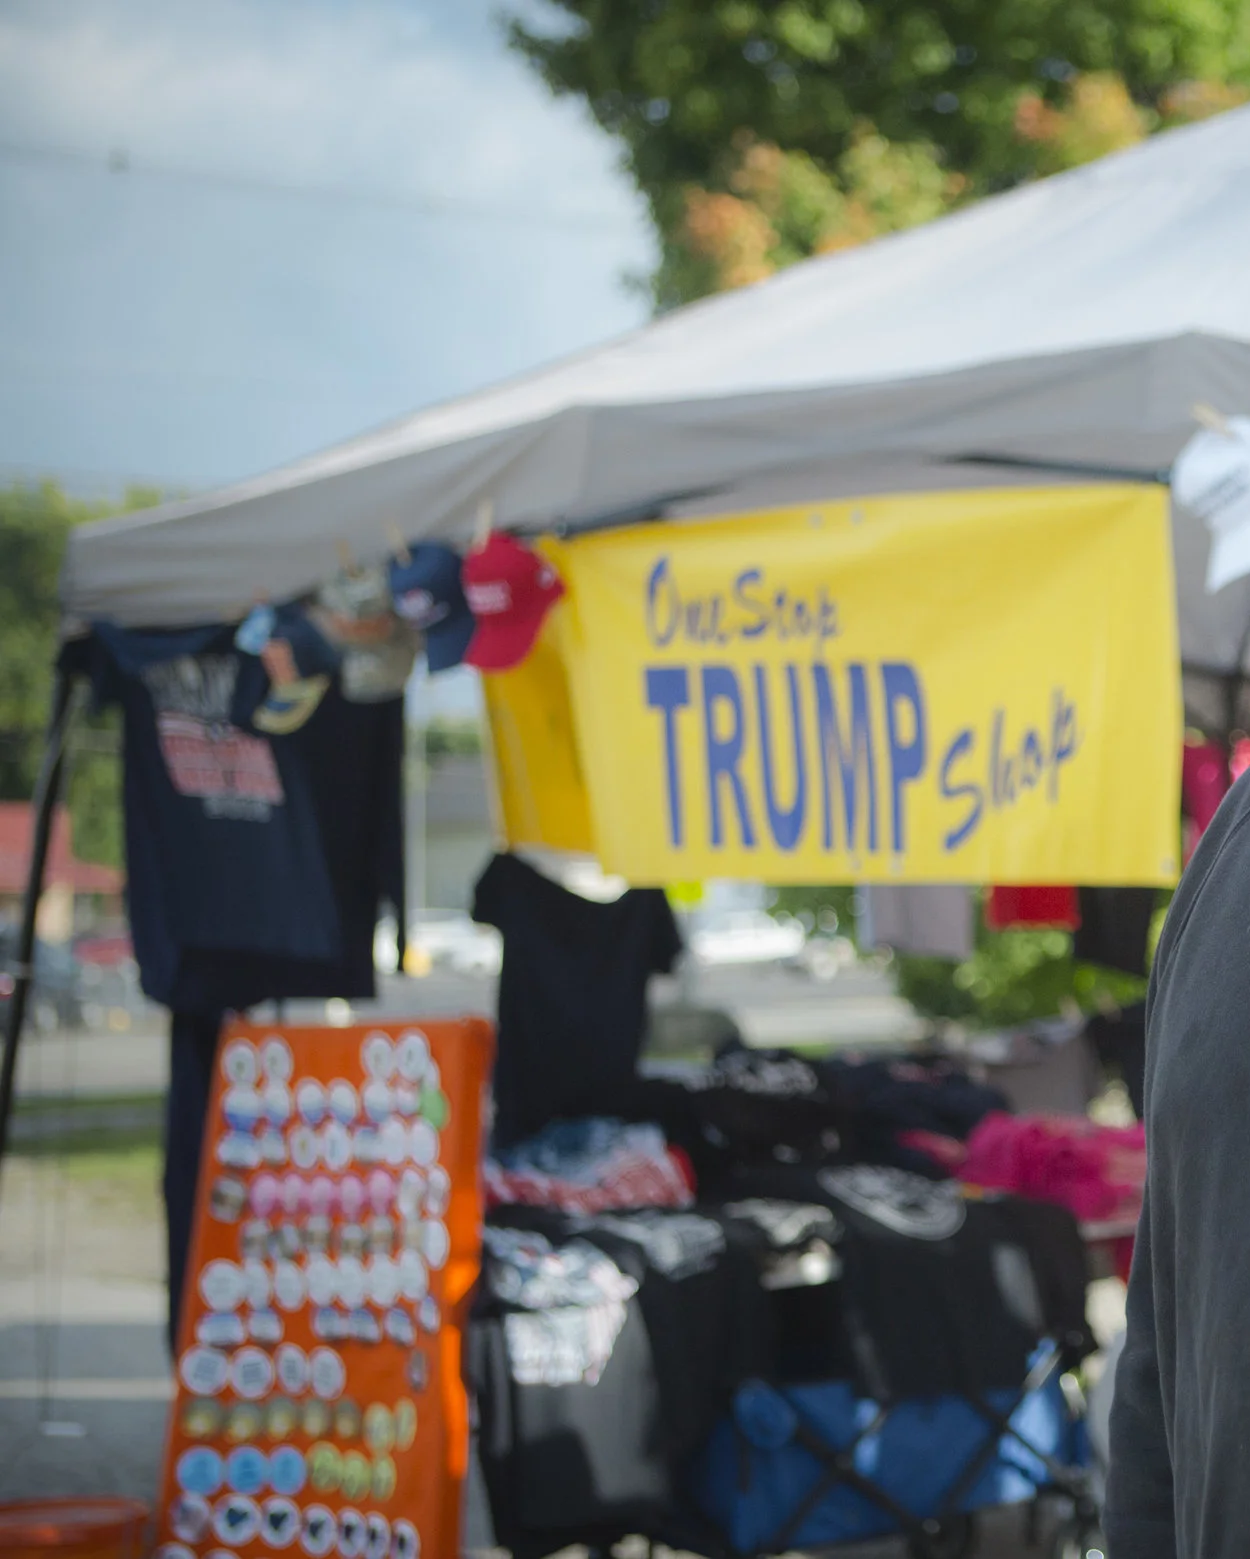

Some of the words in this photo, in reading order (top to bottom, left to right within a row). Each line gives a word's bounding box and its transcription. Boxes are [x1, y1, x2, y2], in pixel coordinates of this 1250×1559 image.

[644, 553, 729, 648] One
[732, 567, 841, 659] Stop
[642, 660, 928, 854] TRUMP
[937, 688, 1083, 853] Shop
